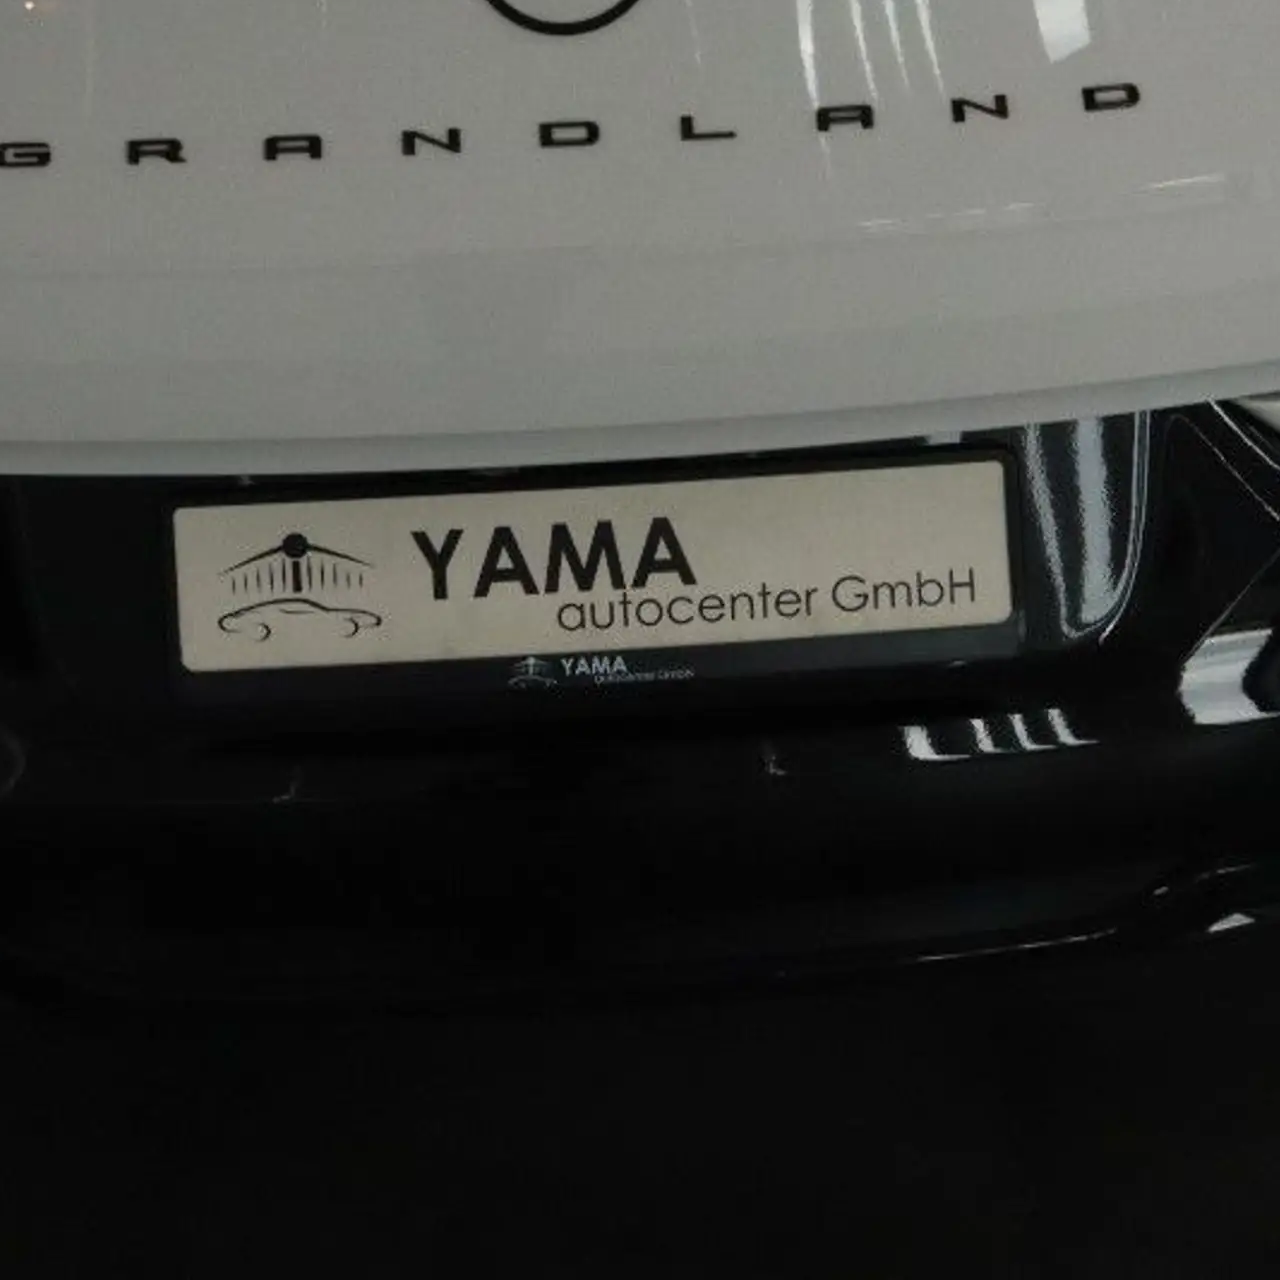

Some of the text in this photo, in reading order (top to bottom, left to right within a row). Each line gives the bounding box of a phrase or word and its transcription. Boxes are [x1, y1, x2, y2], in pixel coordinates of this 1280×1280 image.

[411, 517, 697, 601] YAMA
[557, 568, 976, 631] autocenter GmbH
[560, 655, 628, 677] YAMA
